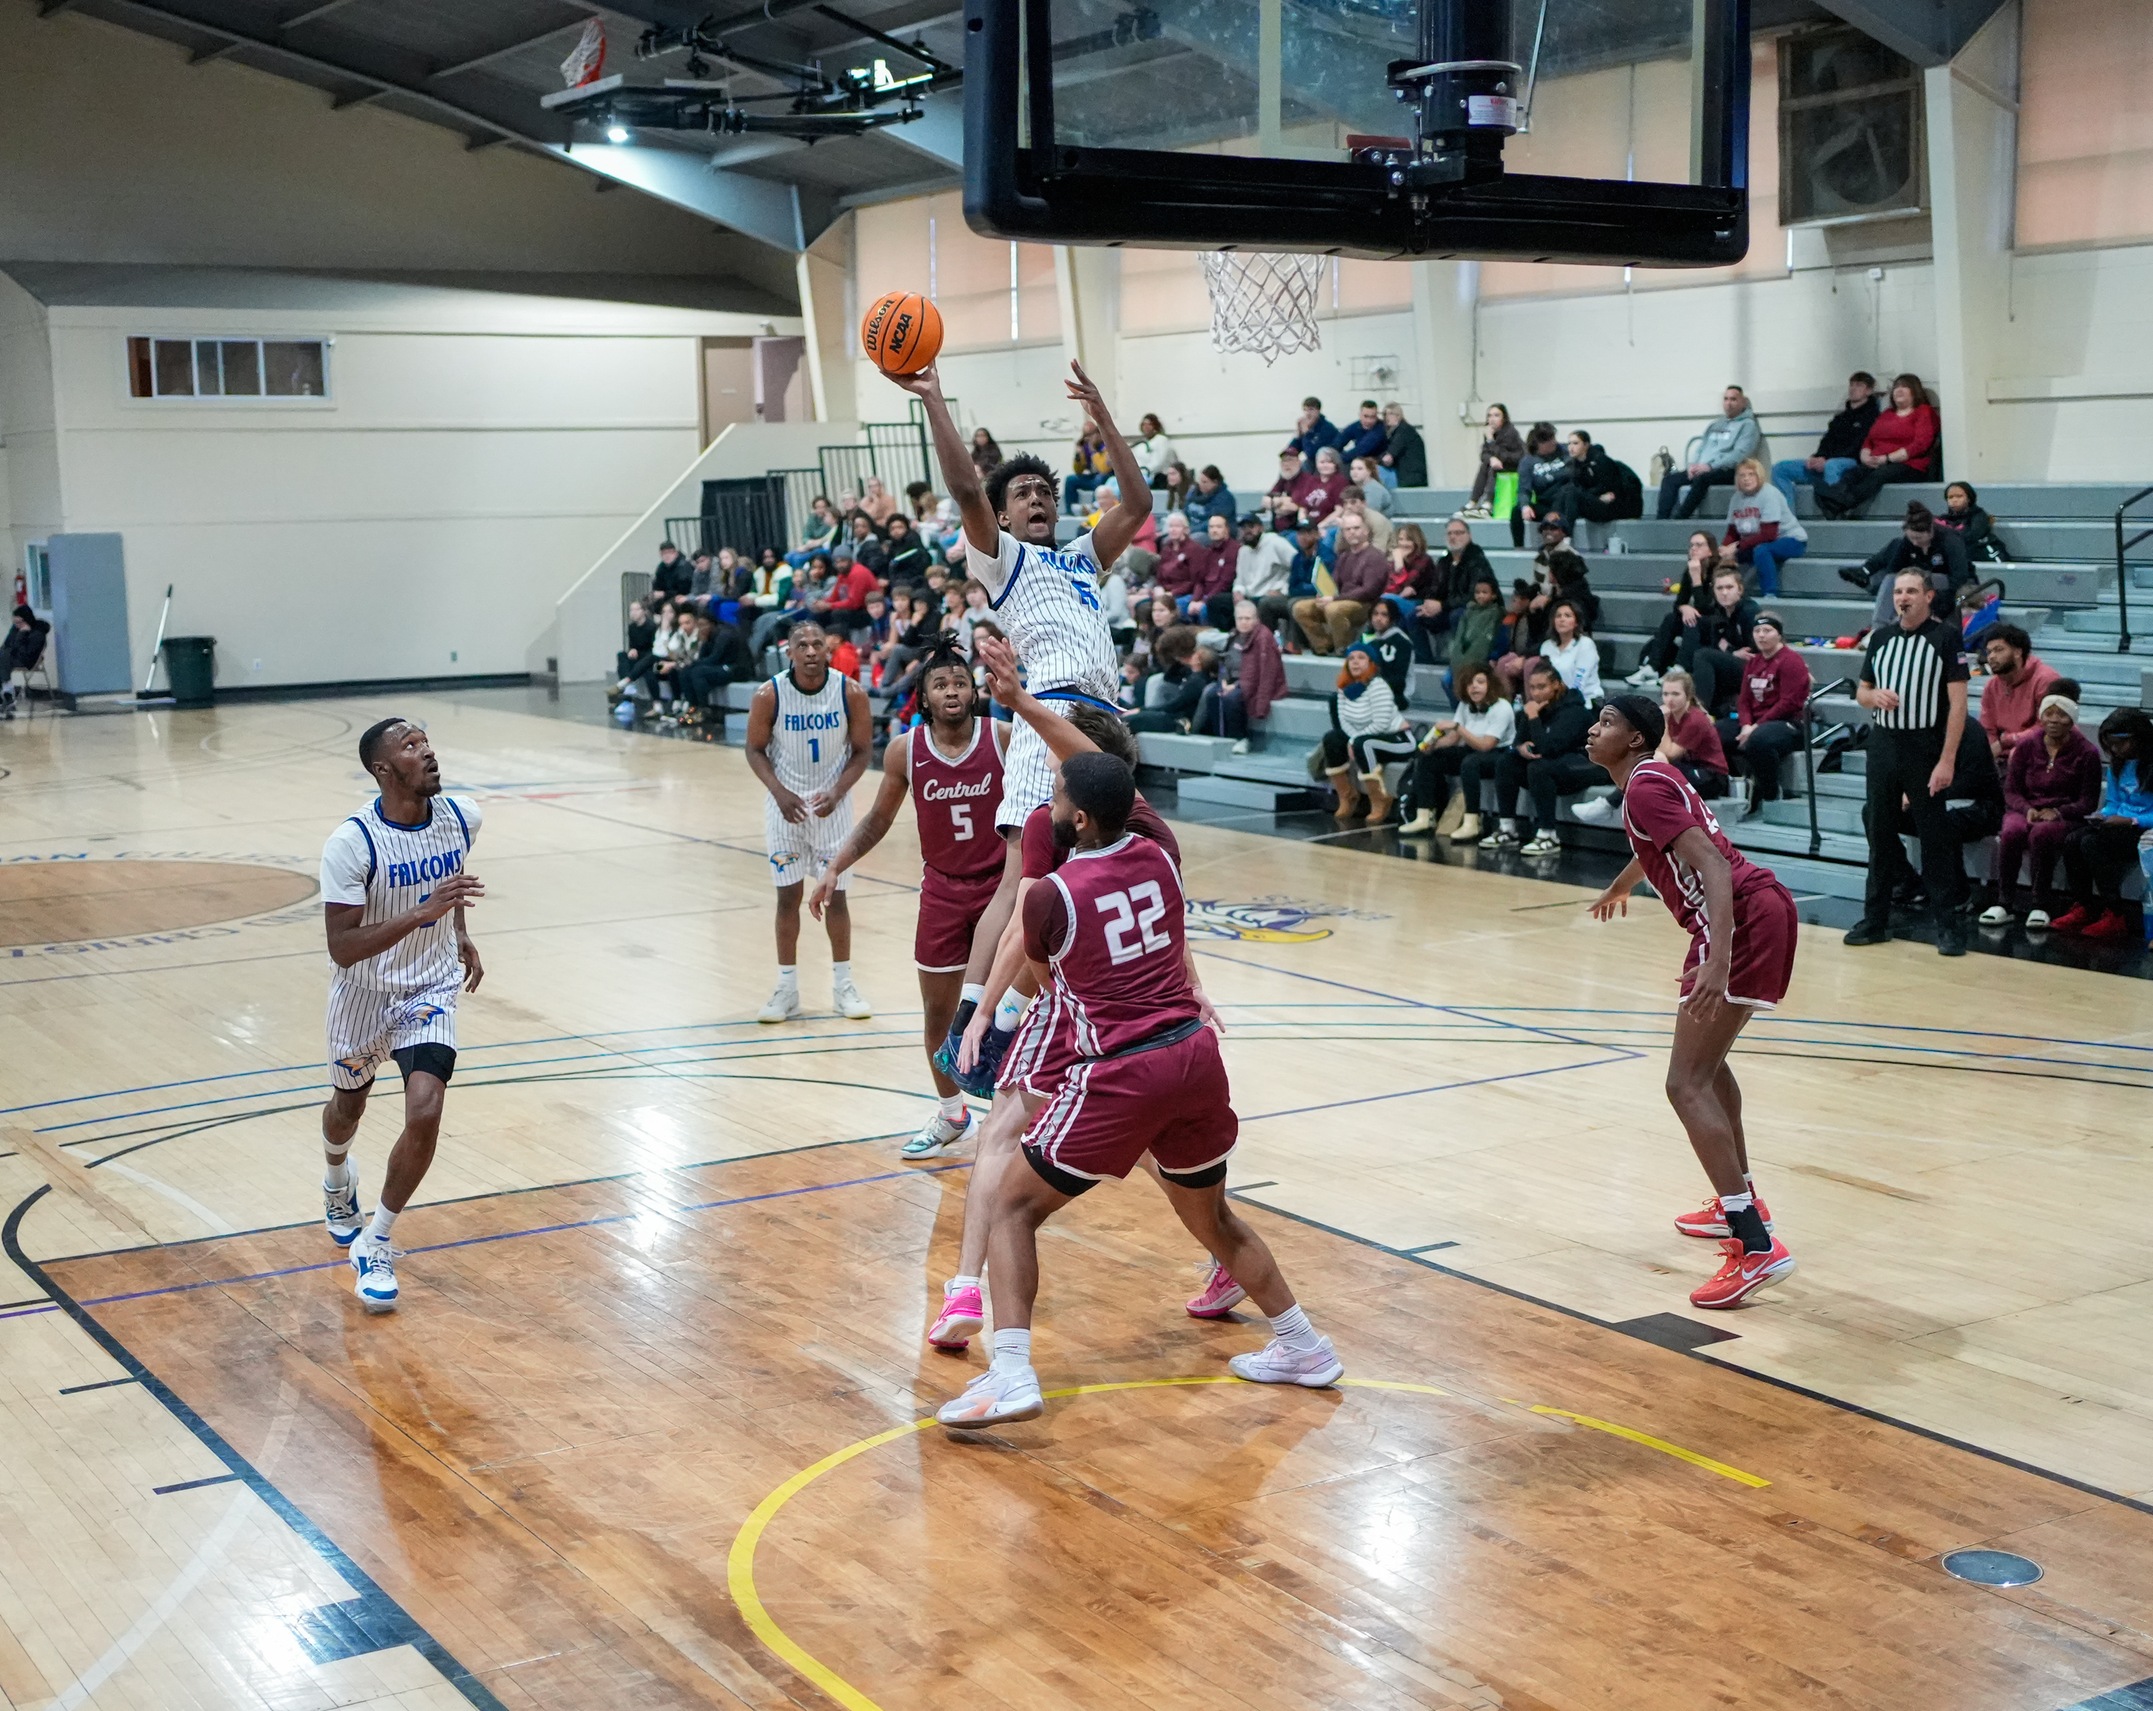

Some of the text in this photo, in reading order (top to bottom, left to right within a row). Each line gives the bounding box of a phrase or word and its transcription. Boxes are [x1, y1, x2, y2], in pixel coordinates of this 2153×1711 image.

[889, 313, 913, 354] NCAA
[785, 711, 839, 731] FALCONS
[807, 738, 819, 763] 1
[923, 772, 992, 801] Central
[950, 804, 974, 841] 5
[388, 849, 461, 888] FALCONS
[1094, 879, 1172, 966] 22
